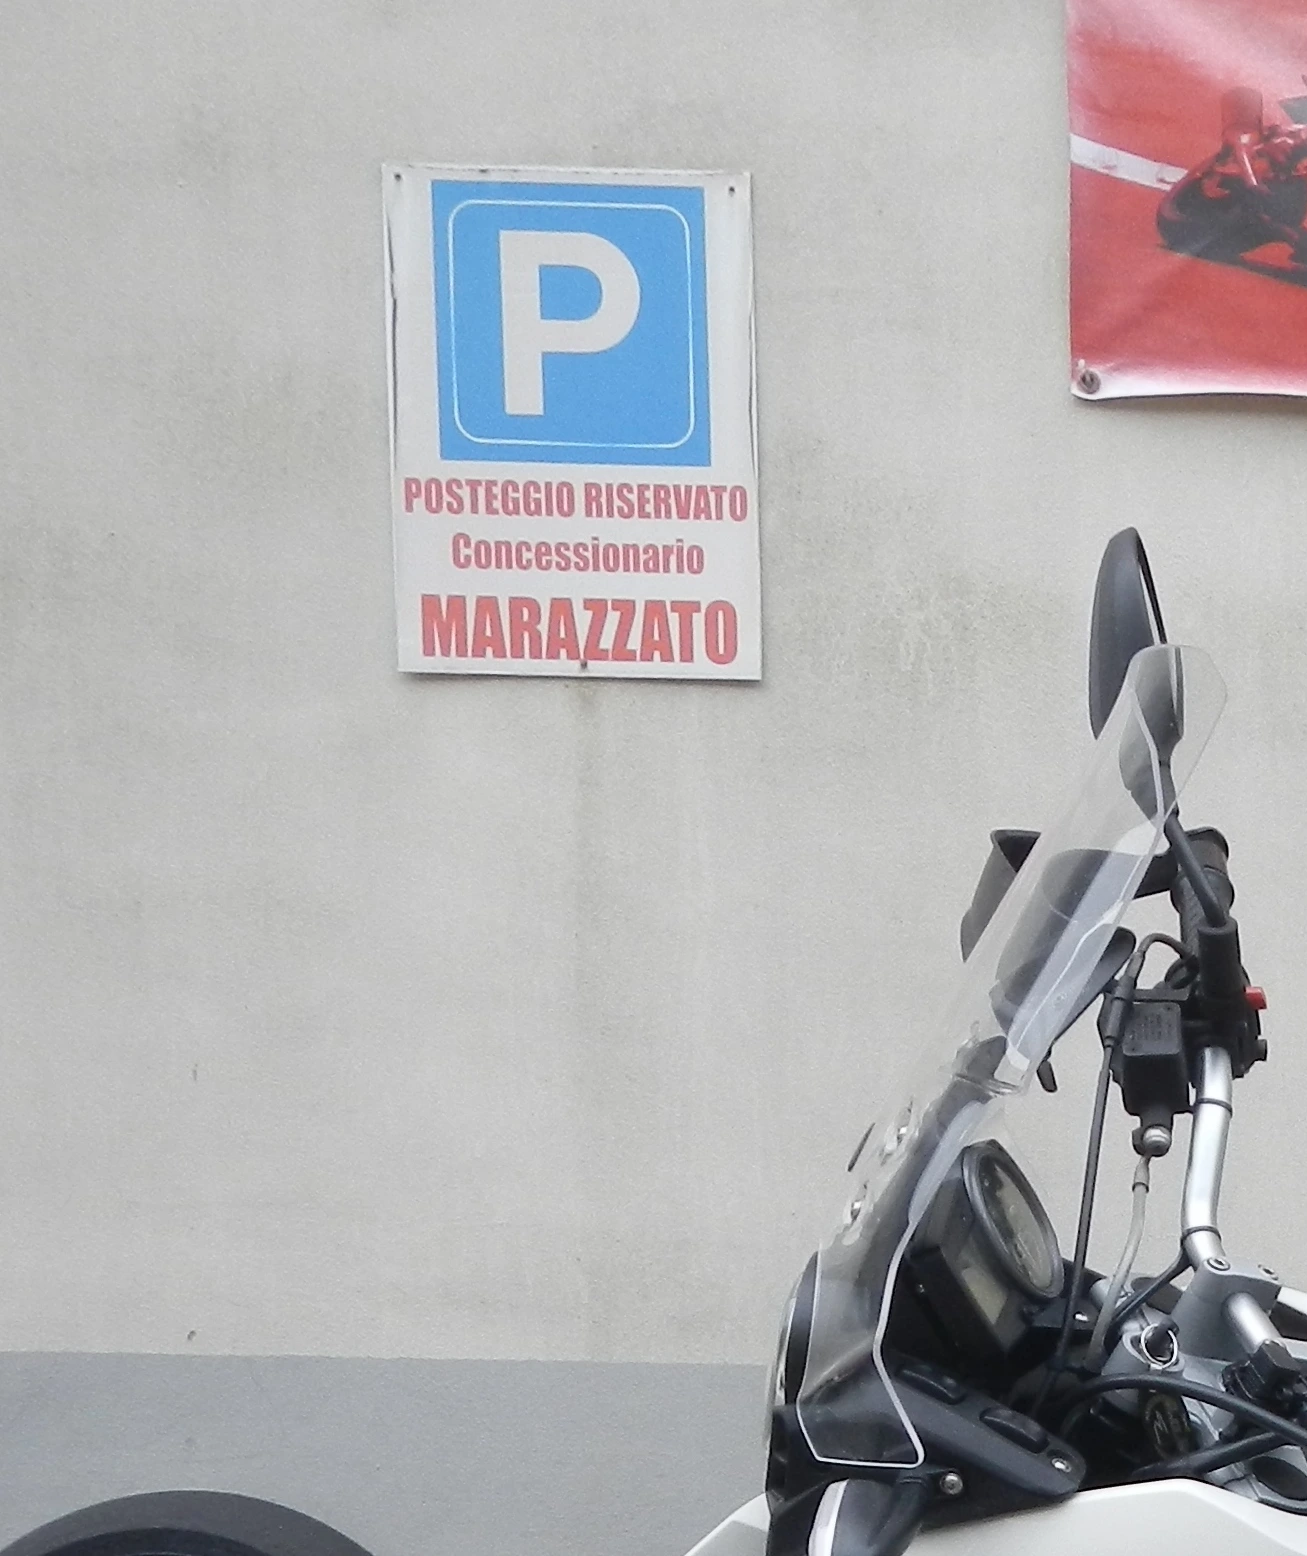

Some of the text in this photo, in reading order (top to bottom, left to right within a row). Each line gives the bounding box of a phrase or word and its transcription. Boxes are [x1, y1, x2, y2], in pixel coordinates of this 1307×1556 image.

[499, 230, 640, 415] P
[404, 478, 747, 522] POSTEGGIO RISERVATO
[452, 533, 704, 574] Concessionario
[421, 595, 737, 664] MARAZZATO
